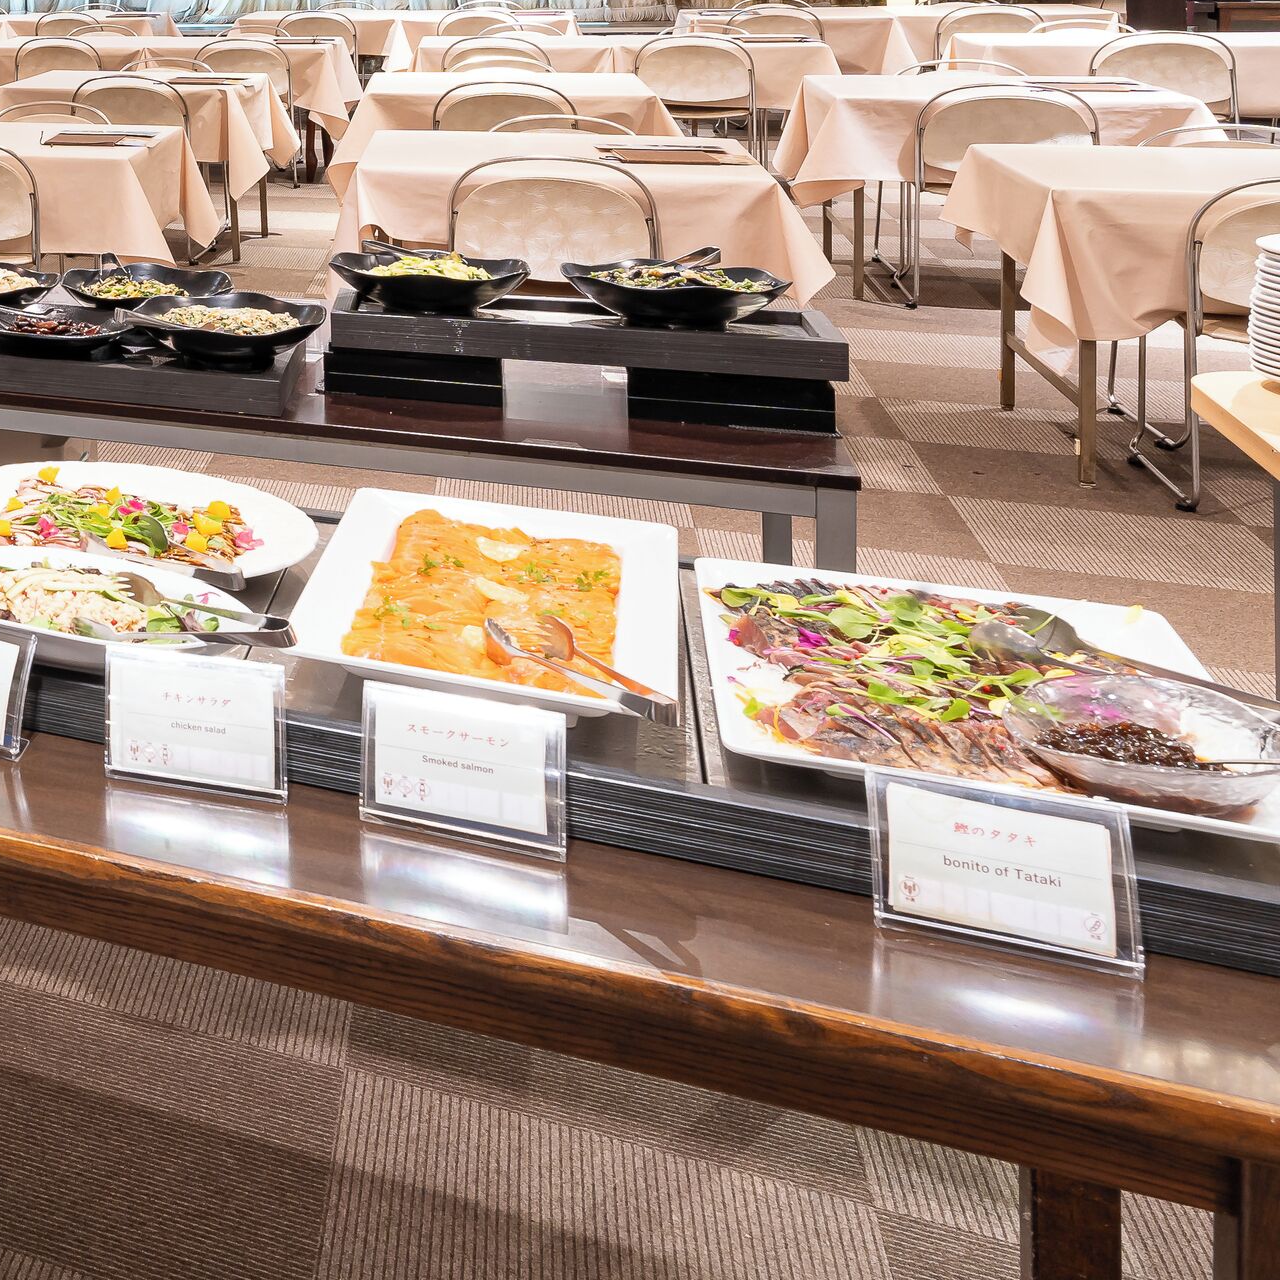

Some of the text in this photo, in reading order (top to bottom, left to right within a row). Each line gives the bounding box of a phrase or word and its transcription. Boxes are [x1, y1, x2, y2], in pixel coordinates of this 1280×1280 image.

[162, 691, 232, 708] チキンサラダ
[171, 721, 226, 735] chicken salad
[407, 723, 510, 748] スモークサーモン
[422, 755, 495, 775] Smoked salmon
[953, 821, 1037, 848] 鰹のタタキ
[943, 854, 1062, 888] bonito of Tataki
